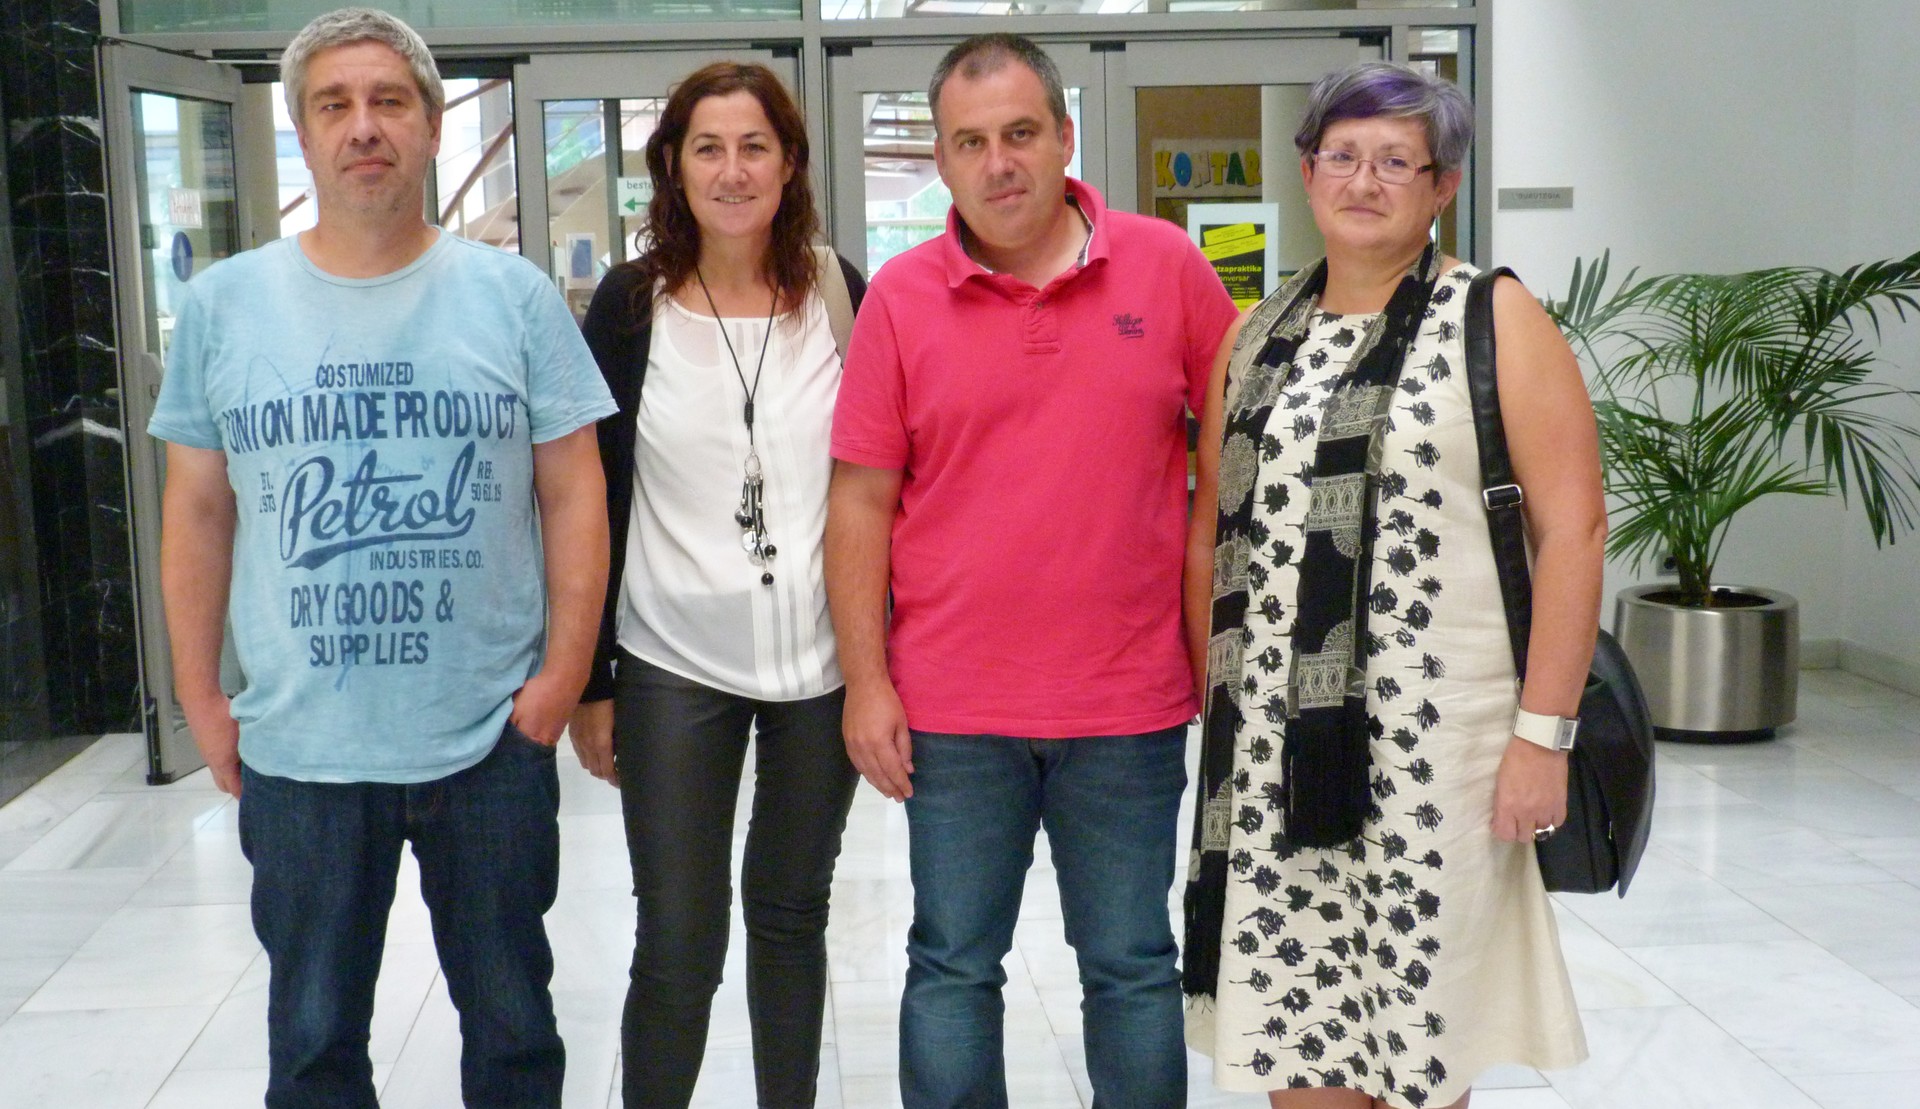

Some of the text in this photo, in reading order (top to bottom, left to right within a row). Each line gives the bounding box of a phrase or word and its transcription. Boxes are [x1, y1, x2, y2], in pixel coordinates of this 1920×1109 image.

[316, 362, 413, 389] COSTUMIZED
[222, 390, 518, 455] UNION MADE PRODUCT
[279, 440, 476, 561] Petrol
[291, 578, 455, 628] DRY GOODS &
[310, 631, 430, 667] SUPPLIES
